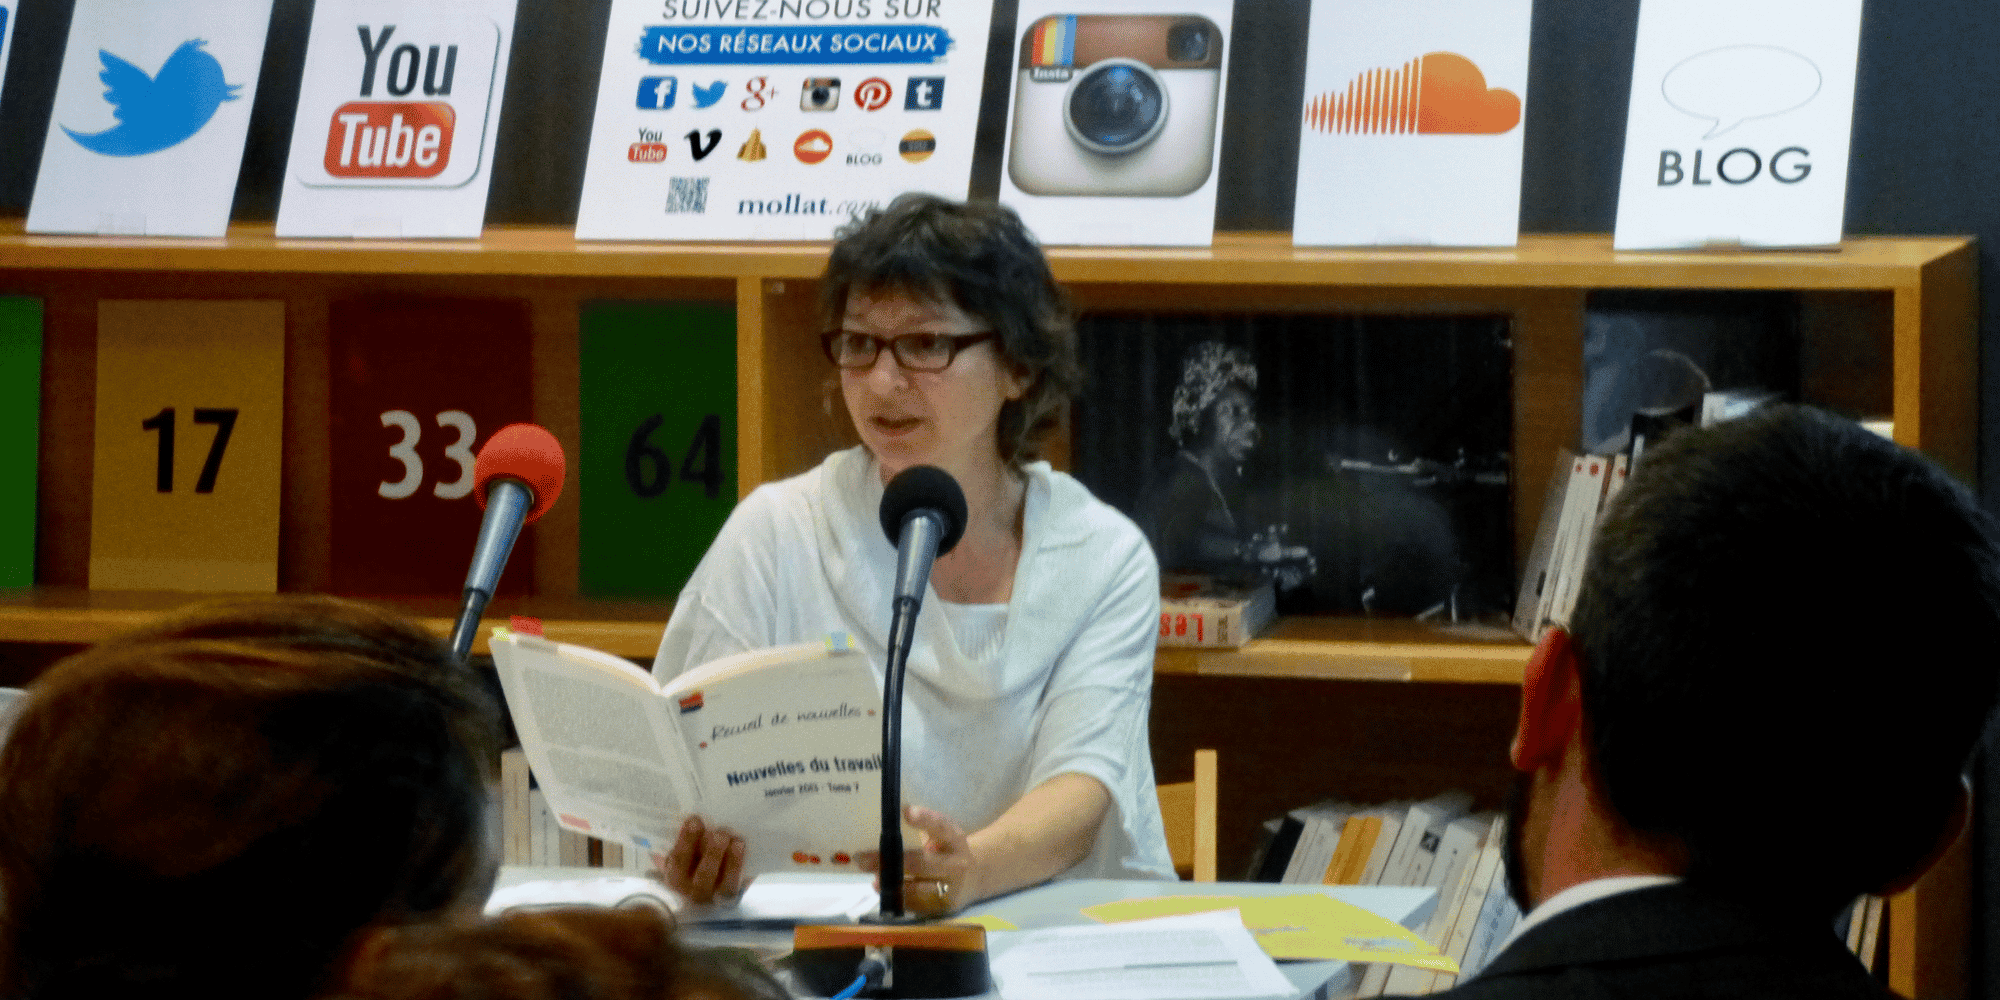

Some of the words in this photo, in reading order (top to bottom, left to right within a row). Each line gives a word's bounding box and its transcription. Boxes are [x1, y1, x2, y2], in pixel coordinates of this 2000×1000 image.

[662, 0, 871, 20] SUIVEZ-NOUS
[884, 0, 941, 19] SUR
[658, 33, 711, 54] NOS
[719, 28, 823, 54] RÉSEAUX
[830, 32, 937, 53] SOCIAUX
[356, 25, 458, 98] You
[338, 113, 442, 169] Tube
[638, 126, 663, 142] You
[633, 145, 665, 160] Tube
[846, 153, 882, 165] BLOG
[1657, 146, 1812, 187] BLOG
[142, 407, 239, 494] 17
[378, 409, 478, 500] 33
[625, 412, 725, 500] 64
[726, 760, 805, 787] Nouvelles
[809, 756, 830, 773] du
